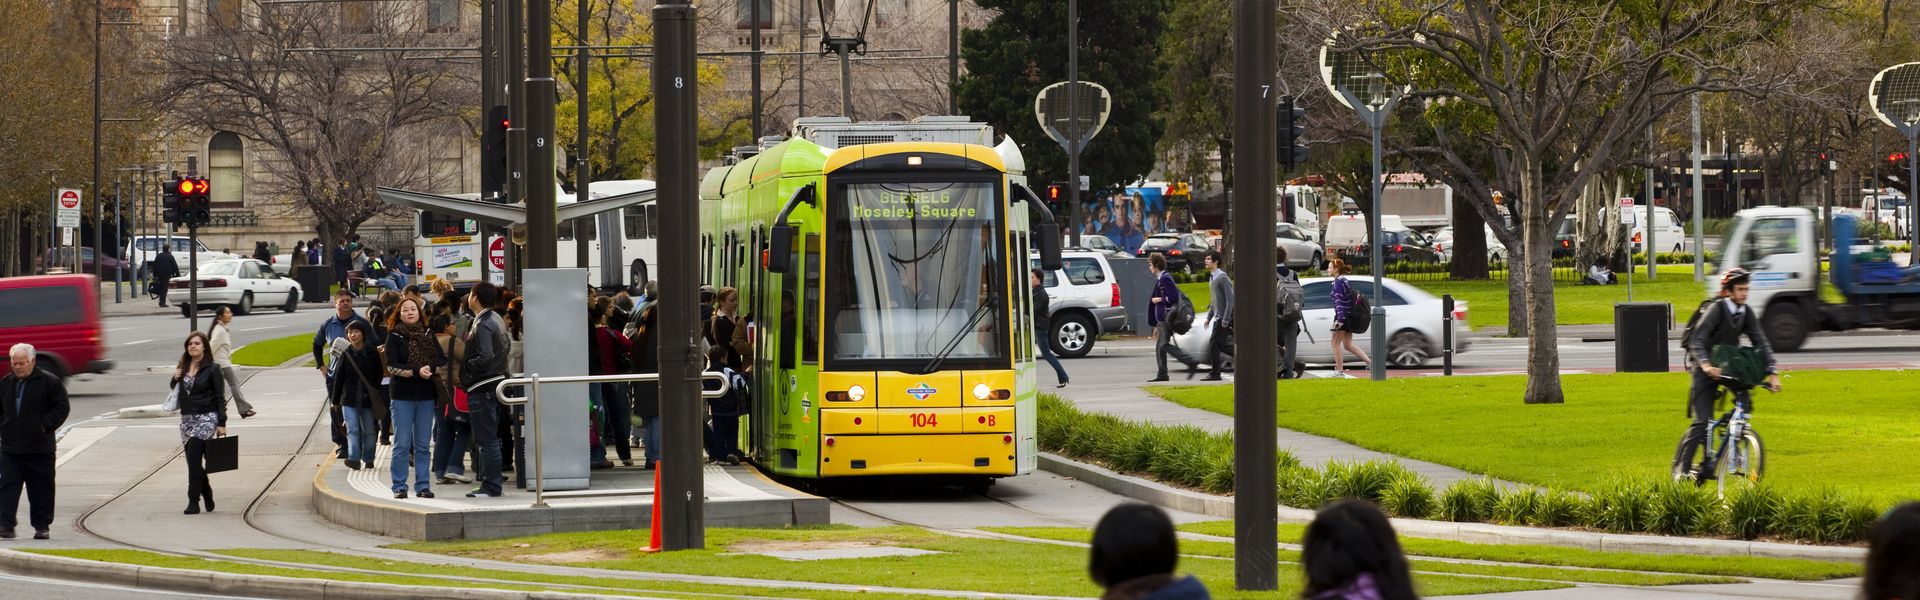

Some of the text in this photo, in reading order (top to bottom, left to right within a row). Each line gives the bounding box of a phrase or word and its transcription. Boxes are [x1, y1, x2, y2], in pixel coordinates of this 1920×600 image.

[675, 76, 683, 89] 8
[1261, 85, 1270, 98] 7
[536, 137, 544, 147] 9
[513, 171, 521, 179] 10
[880, 191, 950, 204] GLENELG
[853, 205, 976, 218] Moseley Square
[909, 413, 938, 427] 104
[988, 415, 995, 426] B
